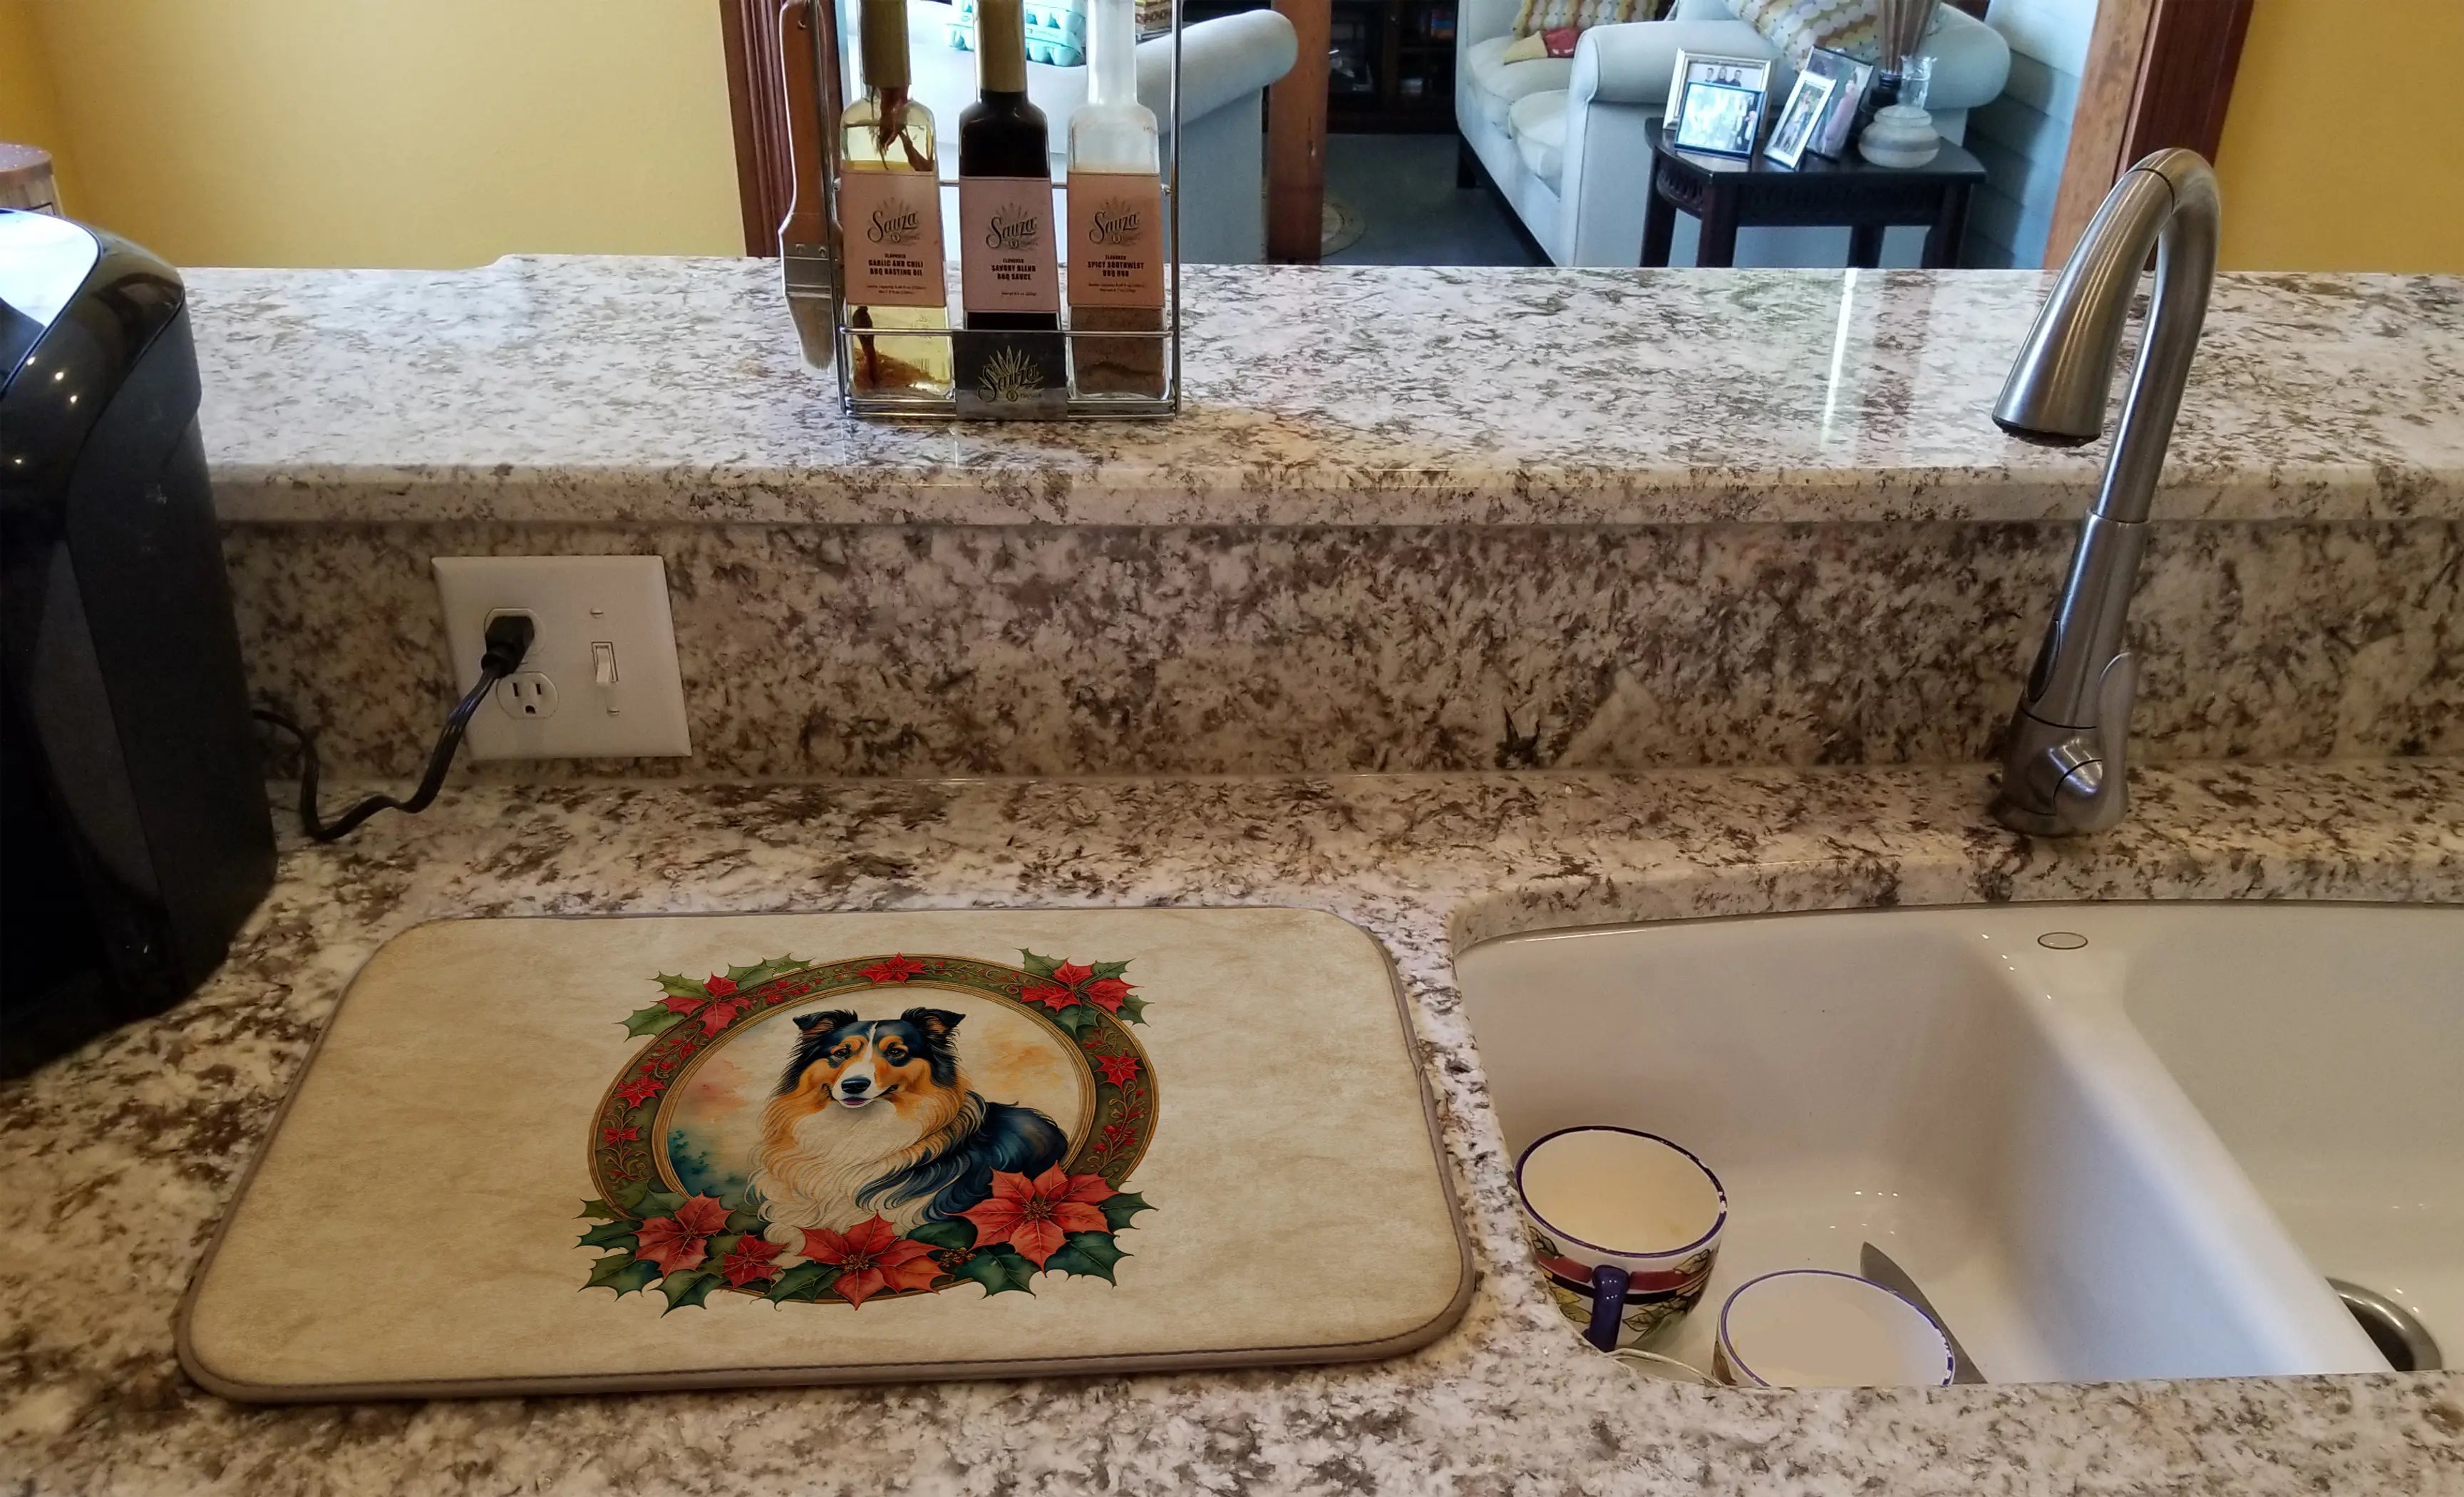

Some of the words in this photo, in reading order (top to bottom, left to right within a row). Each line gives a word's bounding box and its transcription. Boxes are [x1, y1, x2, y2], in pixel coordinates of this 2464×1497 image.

[867, 210, 919, 243] Sauza
[986, 216, 1038, 249] Sauza
[1089, 211, 1140, 244] Sauza
